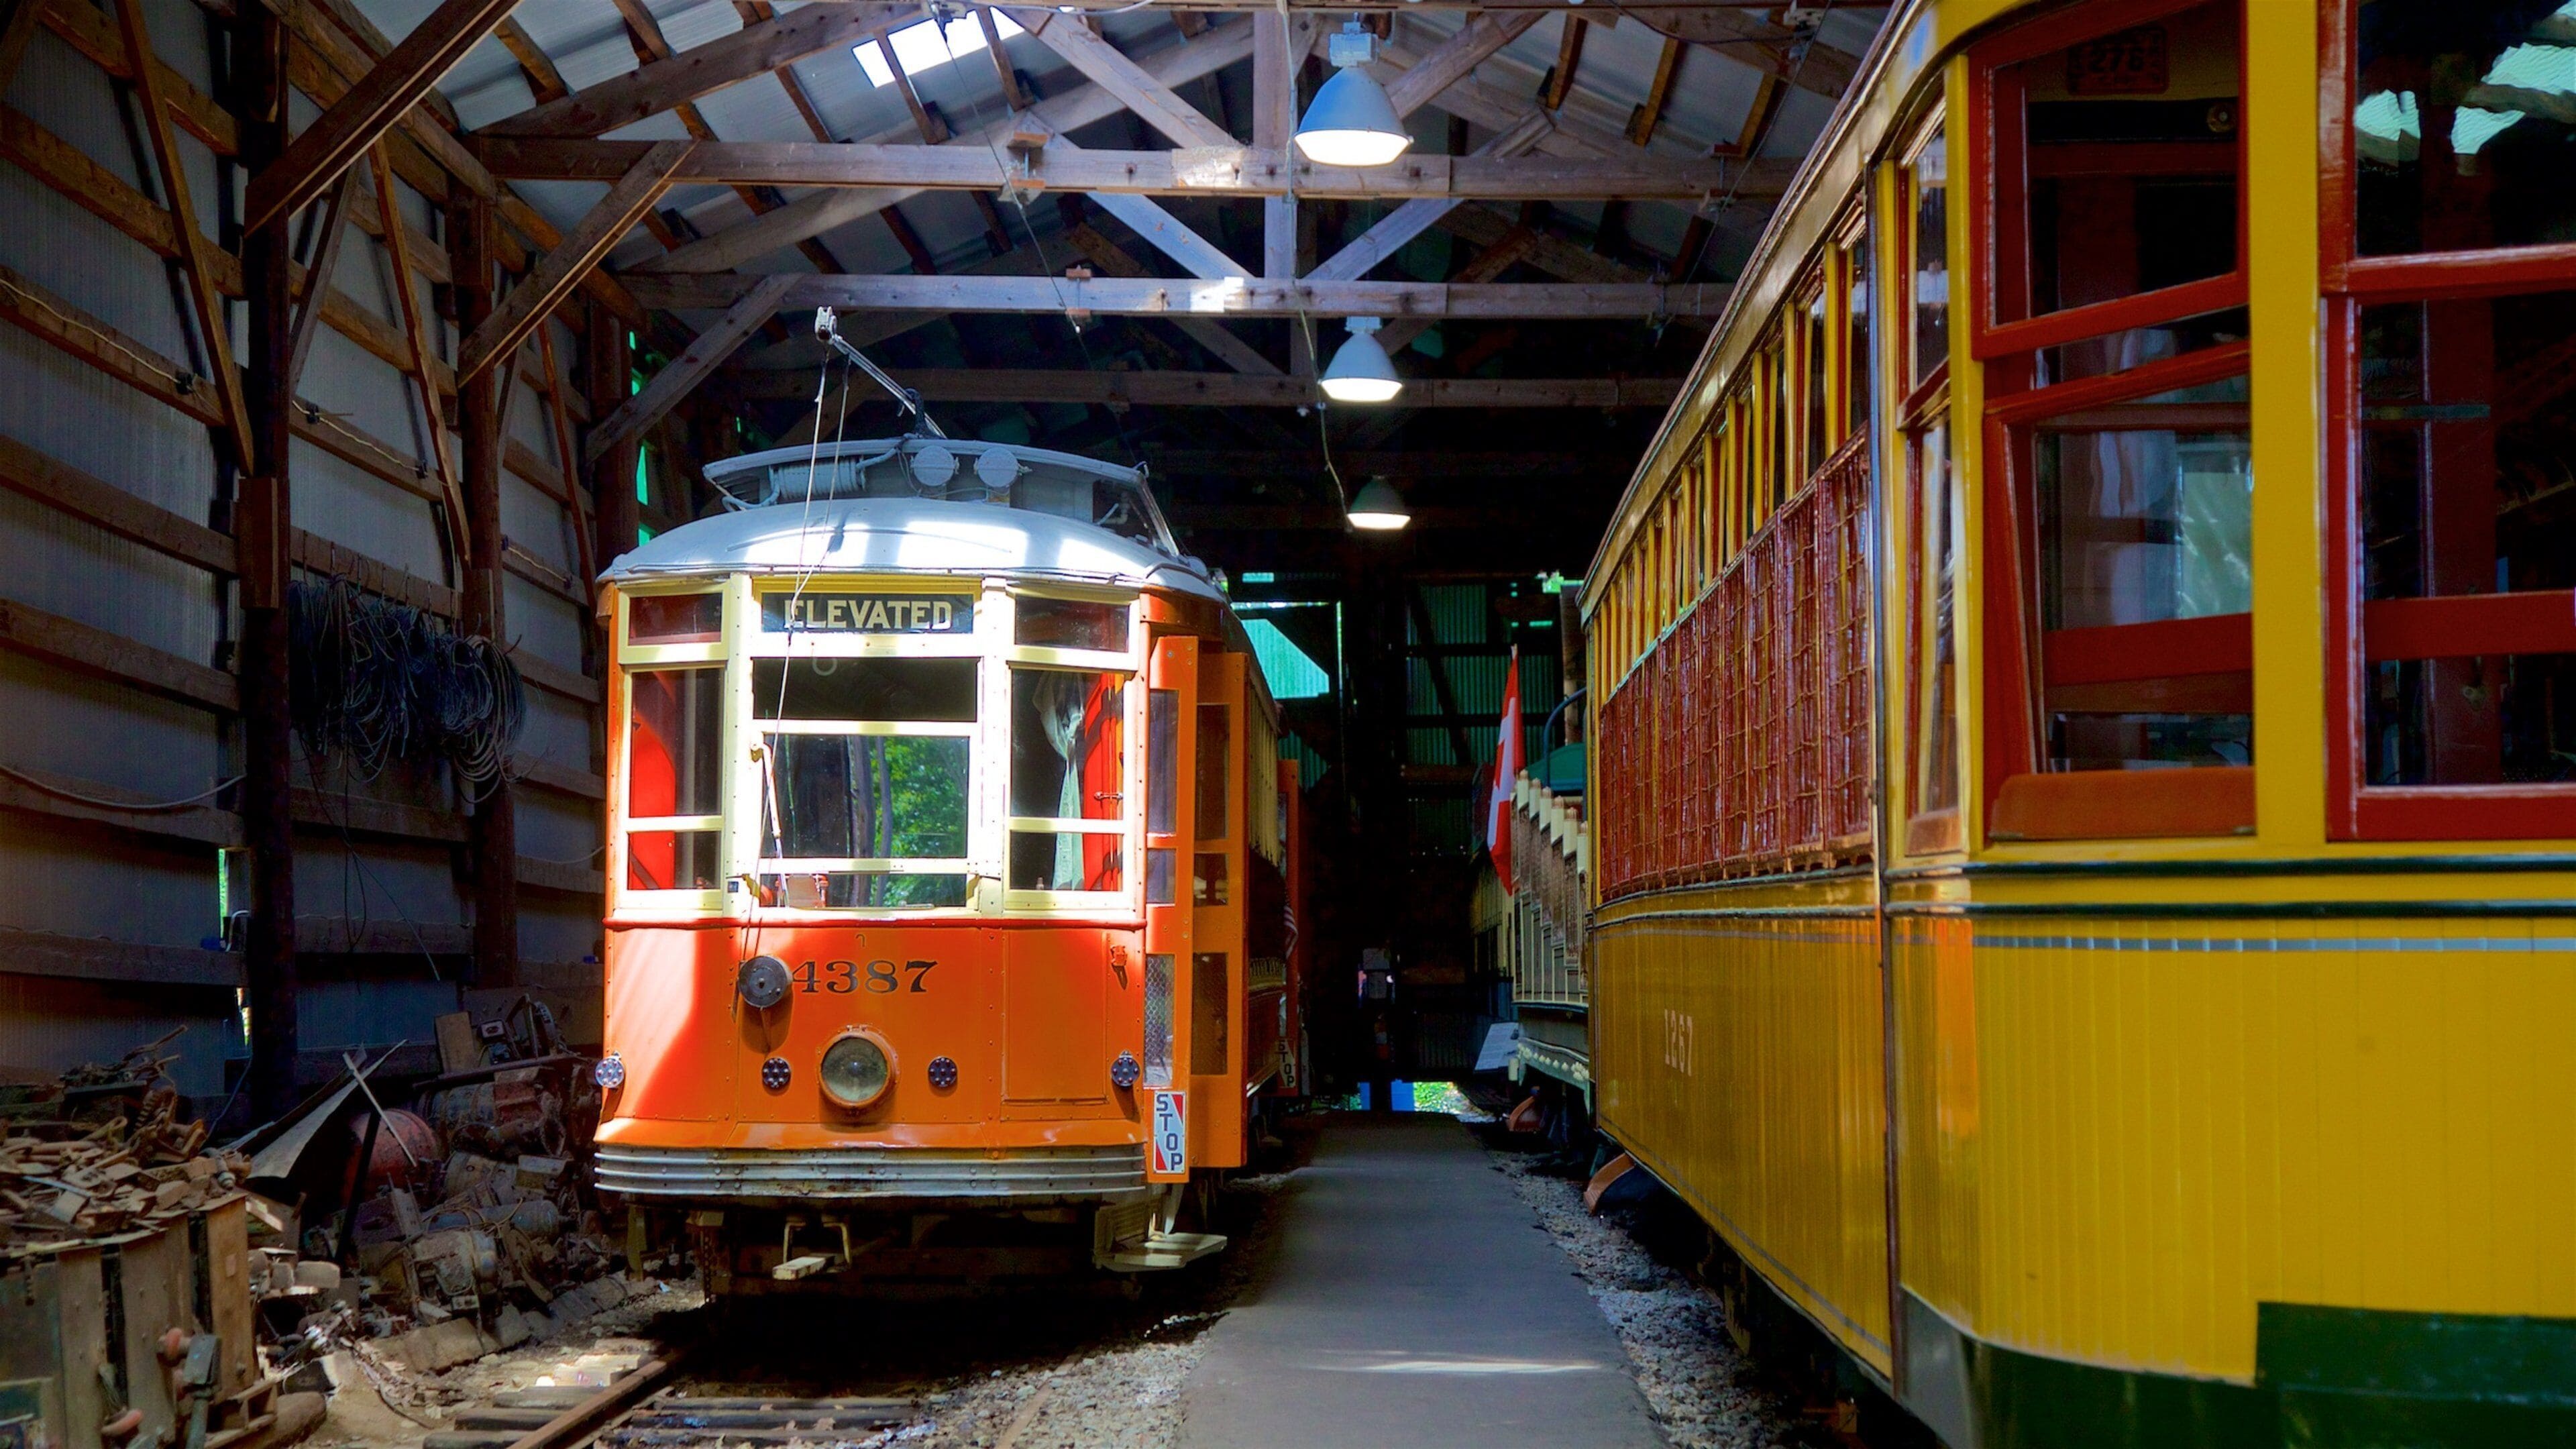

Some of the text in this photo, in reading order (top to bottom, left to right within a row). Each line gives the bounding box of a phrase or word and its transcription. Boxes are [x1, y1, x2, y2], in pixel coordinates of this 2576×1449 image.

[784, 599, 953, 630] ELEVATED
[792, 960, 938, 994] 4387
[1277, 1039, 1295, 1086] STOP
[1664, 1008, 1693, 1077] 1267
[1156, 1093, 1183, 1171] STOP
